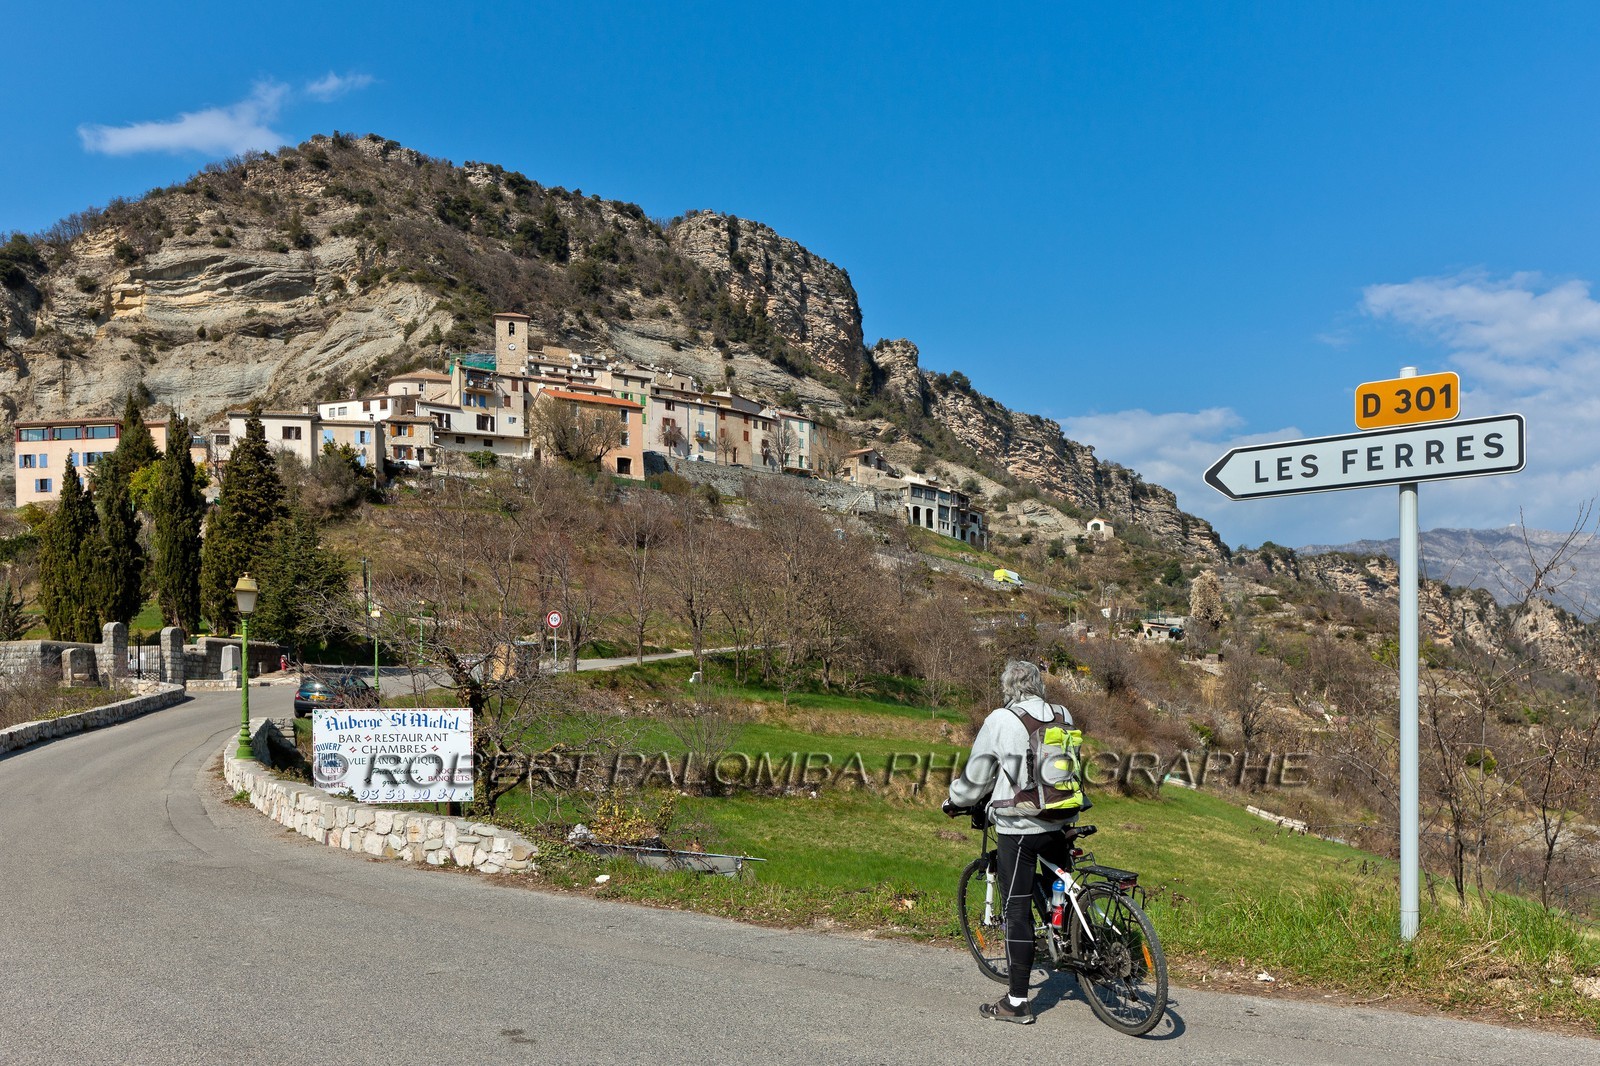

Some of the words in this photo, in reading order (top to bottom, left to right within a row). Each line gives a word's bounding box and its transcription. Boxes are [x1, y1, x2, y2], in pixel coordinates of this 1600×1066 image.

[1362, 393, 1381, 418] D
[1394, 383, 1452, 414] 301
[1254, 453, 1319, 484] LES
[1342, 432, 1504, 475] FERRES
[325, 714, 383, 731] Auberge
[391, 712, 407, 728] St
[410, 712, 460, 730] Michel
[338, 734, 362, 744] BAR
[374, 732, 449, 743] RESTAURANT
[316, 742, 343, 752] OUVERT
[361, 744, 427, 755] CHAMBRES
[348, 757, 367, 765] VUE
[370, 756, 440, 766] PANORAMIQUE
[319, 781, 346, 789] CARTE
